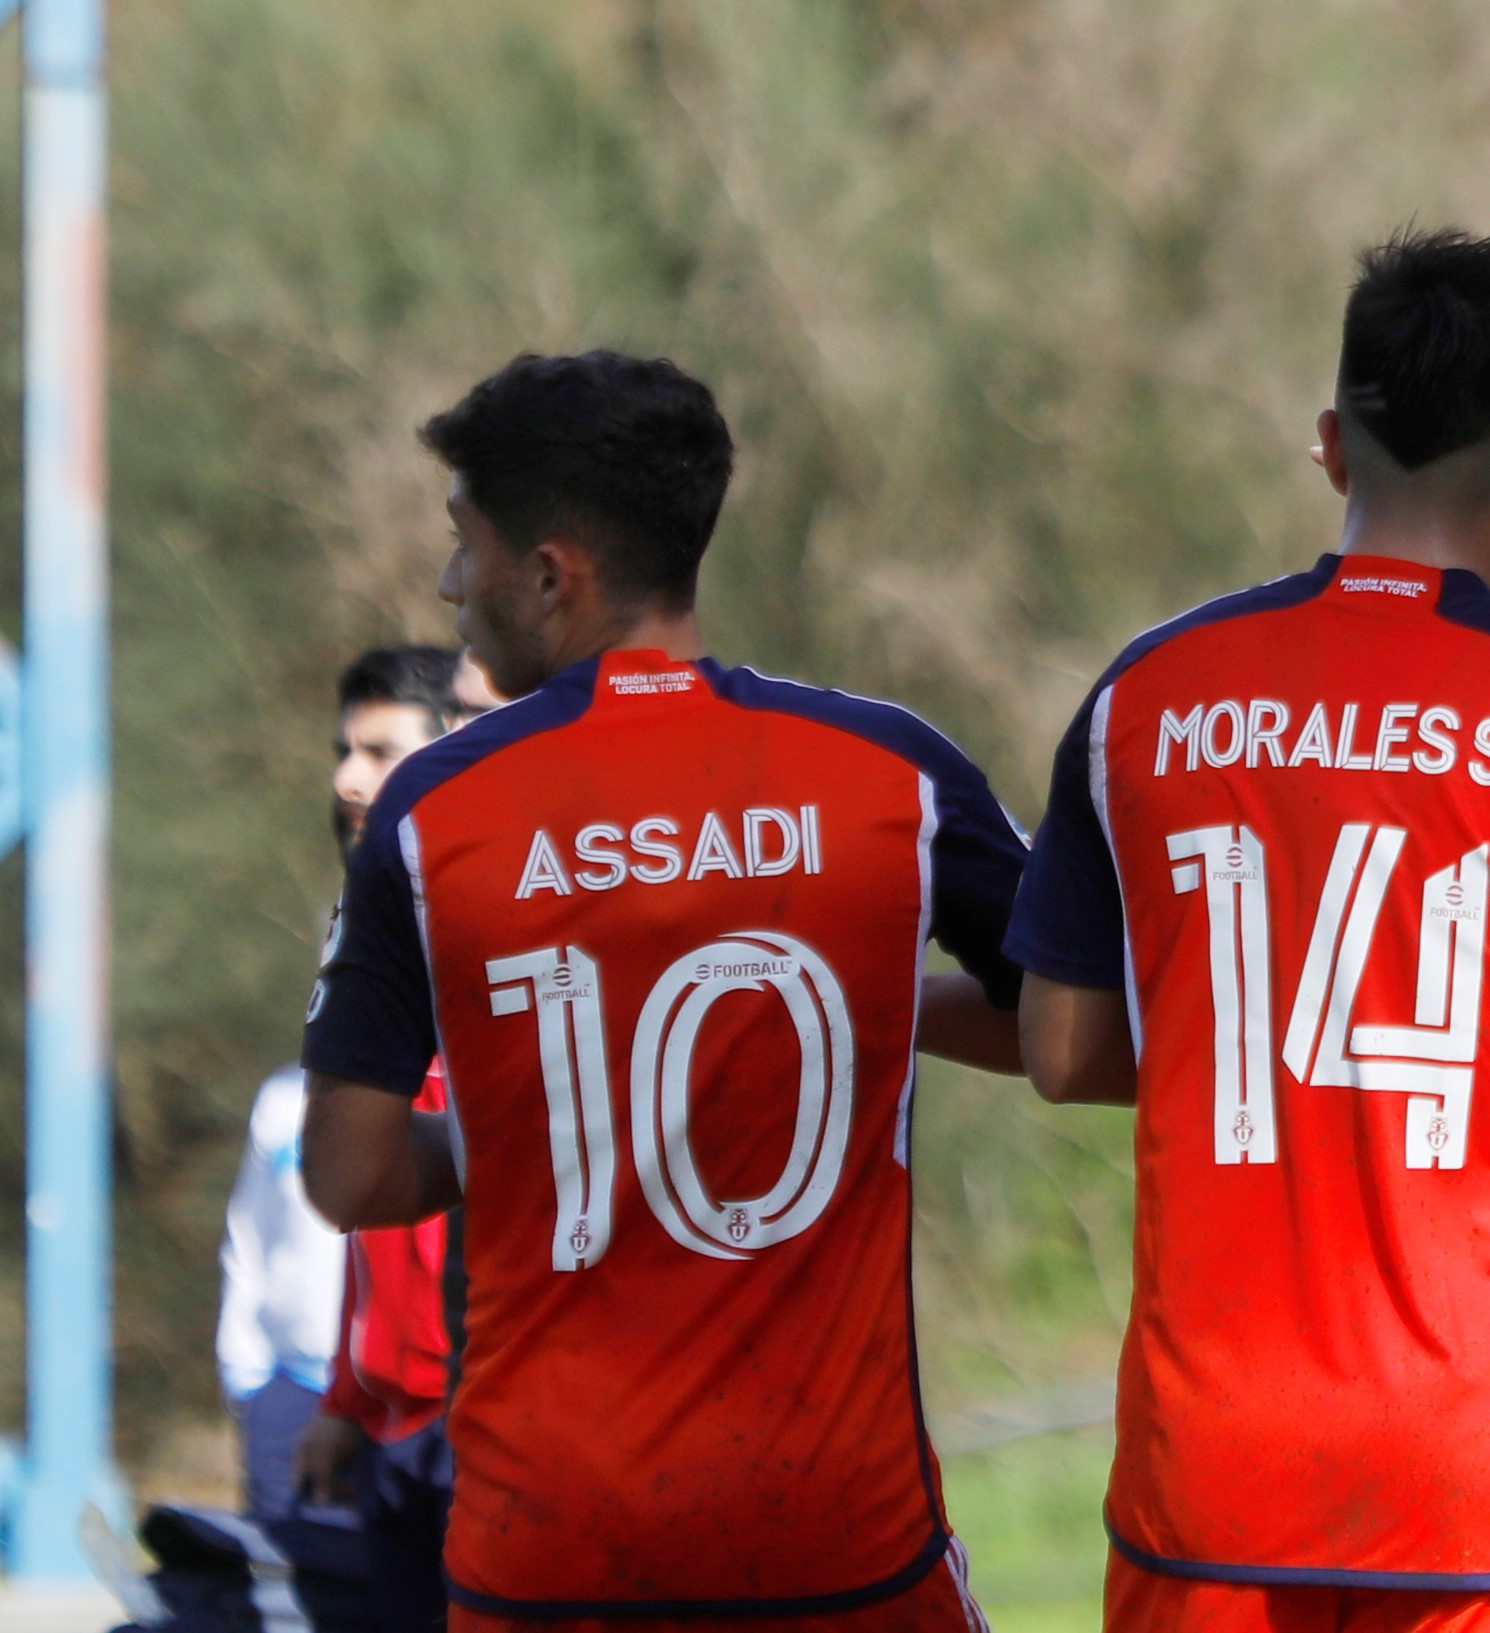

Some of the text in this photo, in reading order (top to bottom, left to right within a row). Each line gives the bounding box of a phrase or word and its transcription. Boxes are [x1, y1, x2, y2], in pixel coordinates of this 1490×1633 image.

[1387, 586, 1418, 598] TOTAL
[615, 684, 658, 695] LOCURA
[1154, 699, 1460, 777] MORALES
[514, 805, 821, 900] ASSADI
[1213, 872, 1257, 881] FOOTBALL
[1430, 907, 1479, 921] FOOTBALL
[1165, 822, 1490, 1170] 14
[485, 931, 854, 1272] 10
